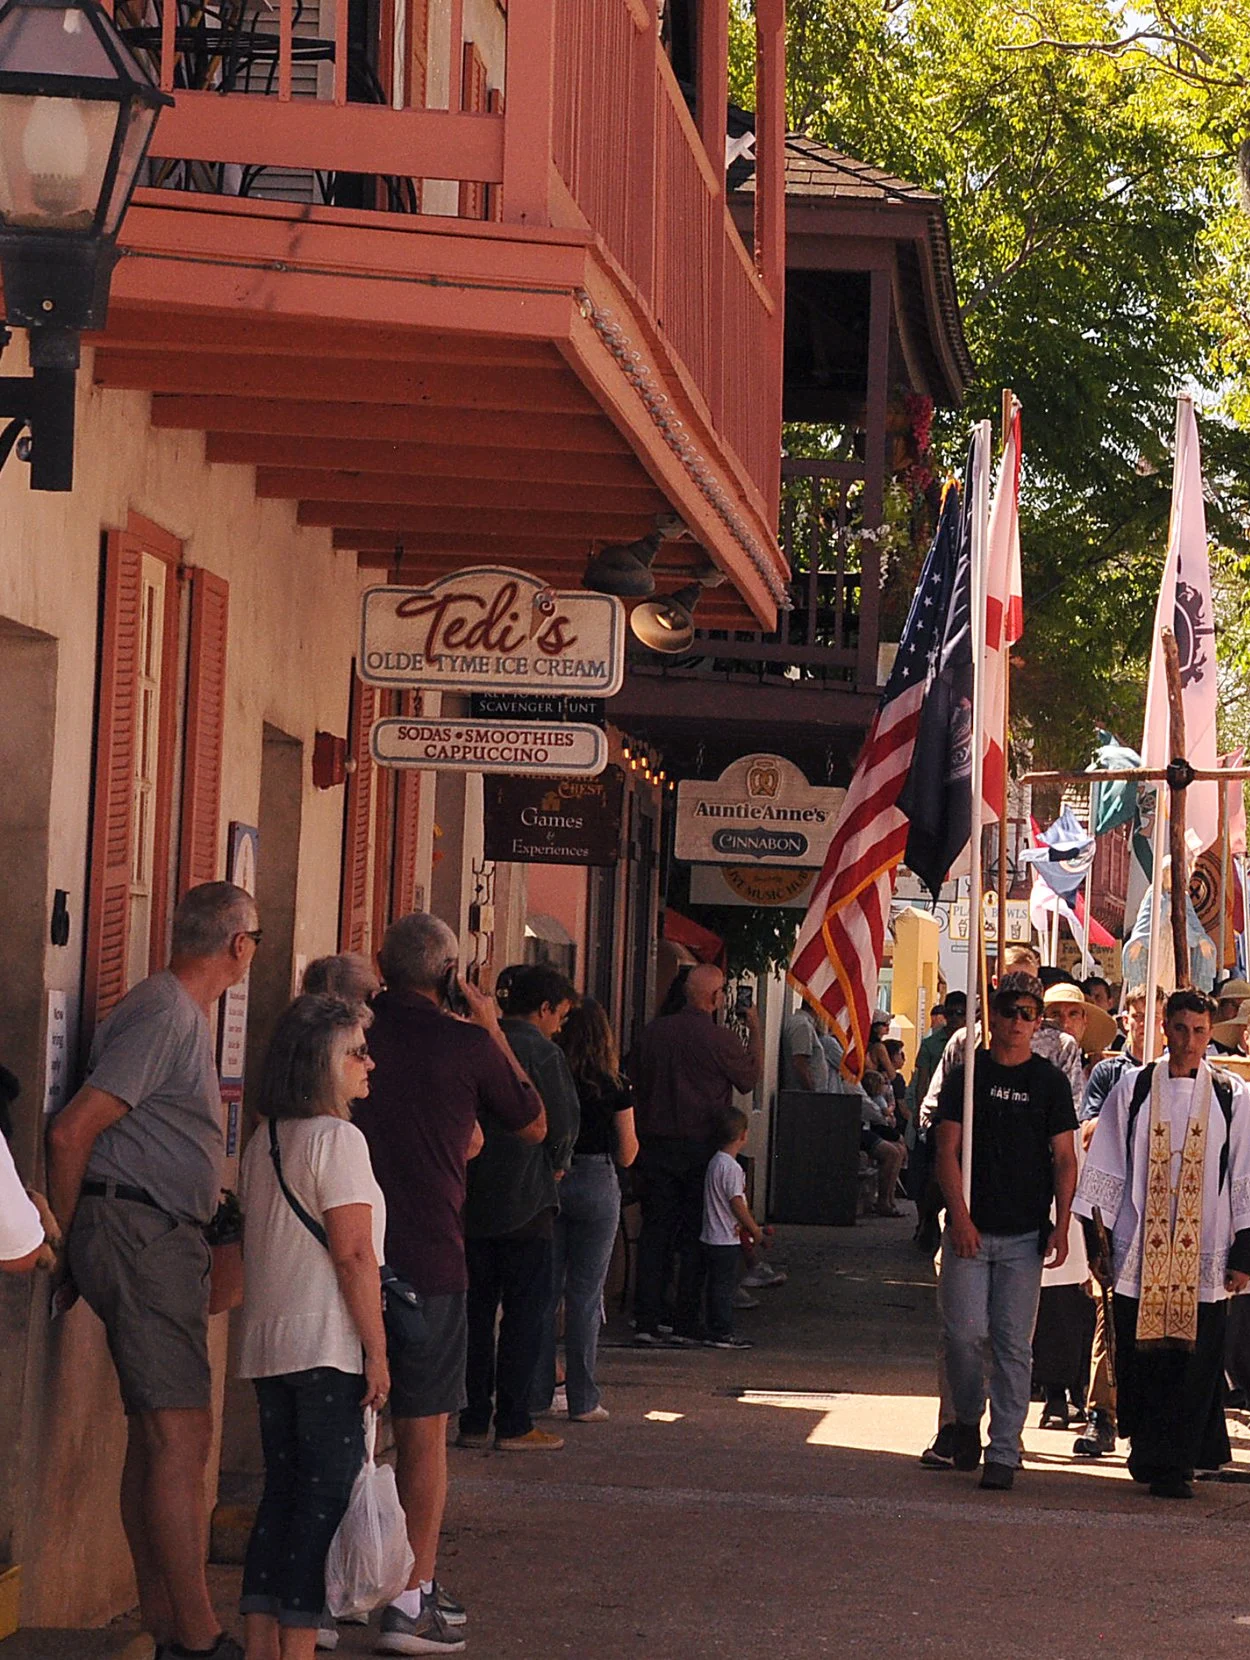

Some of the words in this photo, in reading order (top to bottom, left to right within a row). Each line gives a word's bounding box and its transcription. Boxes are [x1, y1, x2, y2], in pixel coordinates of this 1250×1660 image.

[395, 581, 578, 665] Tedi's
[366, 651, 424, 673] OLDE
[436, 654, 490, 675] TYME
[495, 657, 529, 675] ICE
[533, 658, 608, 678] CREAM
[480, 700, 553, 713] SCAVENGER
[398, 726, 451, 742] SODAS
[465, 729, 574, 747] SMOOTHIES
[424, 745, 549, 763] CAPPUCCINO
[521, 807, 583, 828] Games
[695, 802, 761, 820] Auntie
[763, 805, 827, 823] Anne's
[512, 839, 589, 857] Experiences
[719, 833, 802, 851] CINNABON
[991, 907, 1028, 919] BWLS
